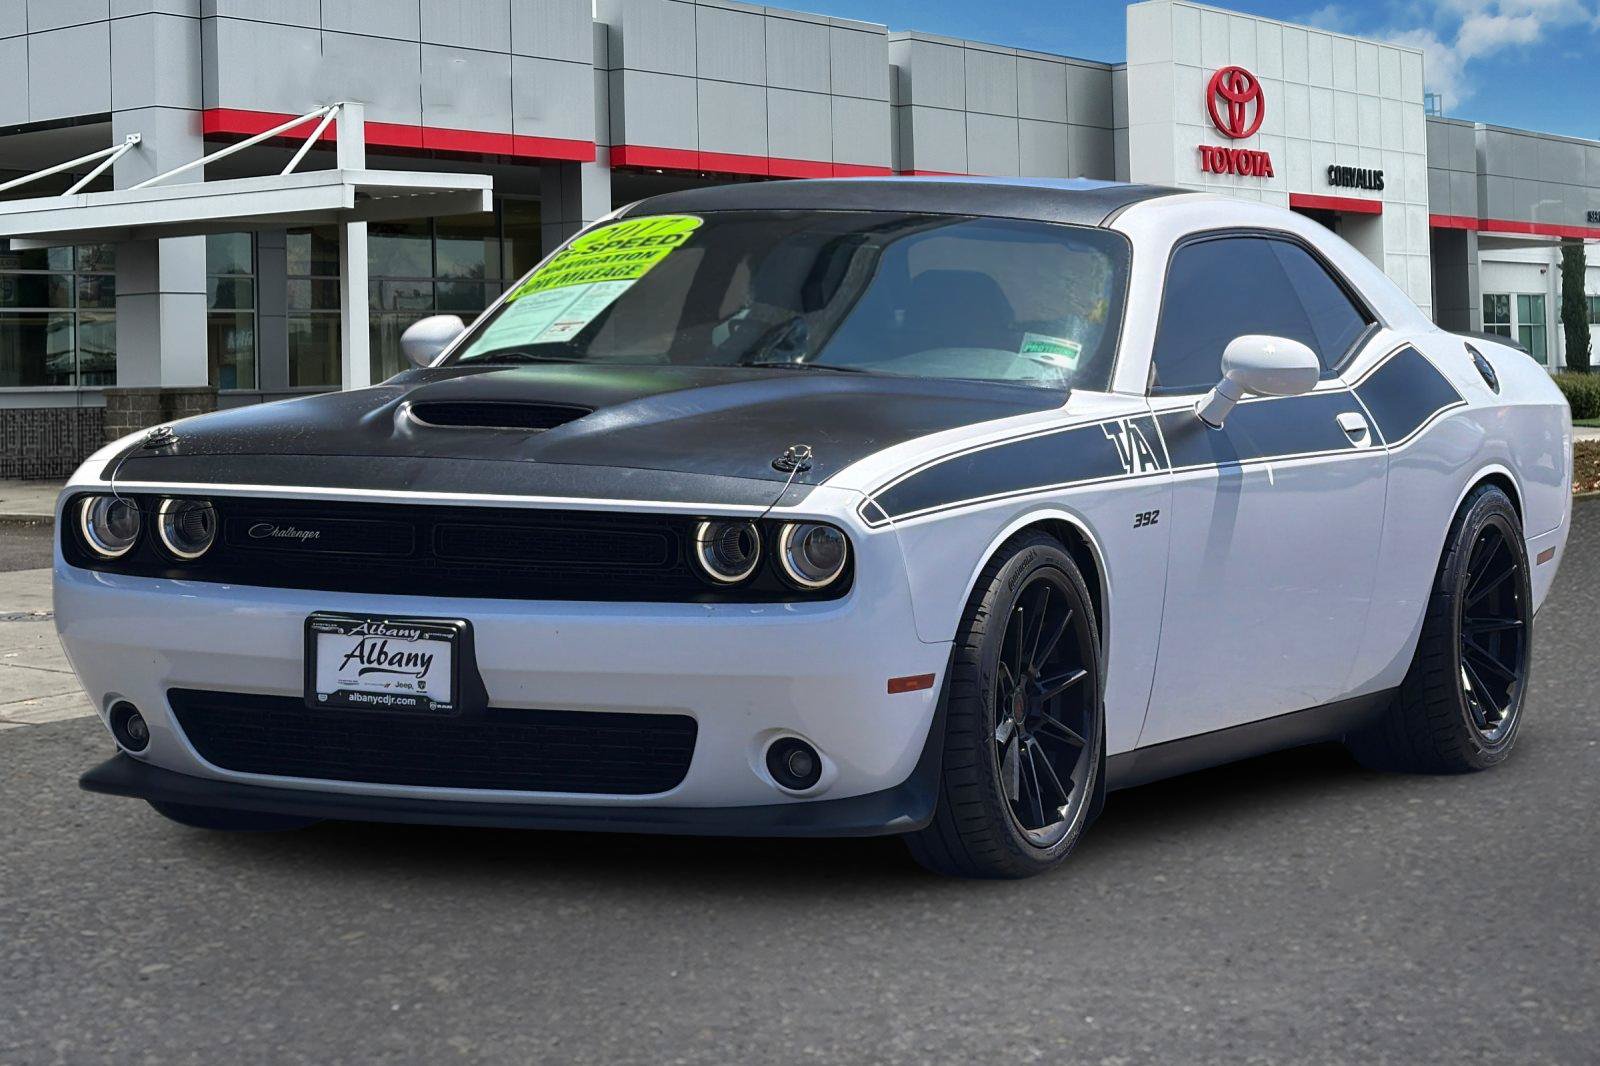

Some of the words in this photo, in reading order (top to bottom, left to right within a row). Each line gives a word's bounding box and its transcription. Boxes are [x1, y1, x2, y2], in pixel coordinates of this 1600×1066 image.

[1198, 145, 1274, 178] TOYOTA
[1327, 164, 1384, 191] CORVALLIS
[1133, 509, 1160, 529] 392
[248, 523, 321, 542] Challenger
[347, 622, 421, 642] Albany
[338, 639, 434, 679] Albany
[349, 692, 416, 706] albanycdjr.com
